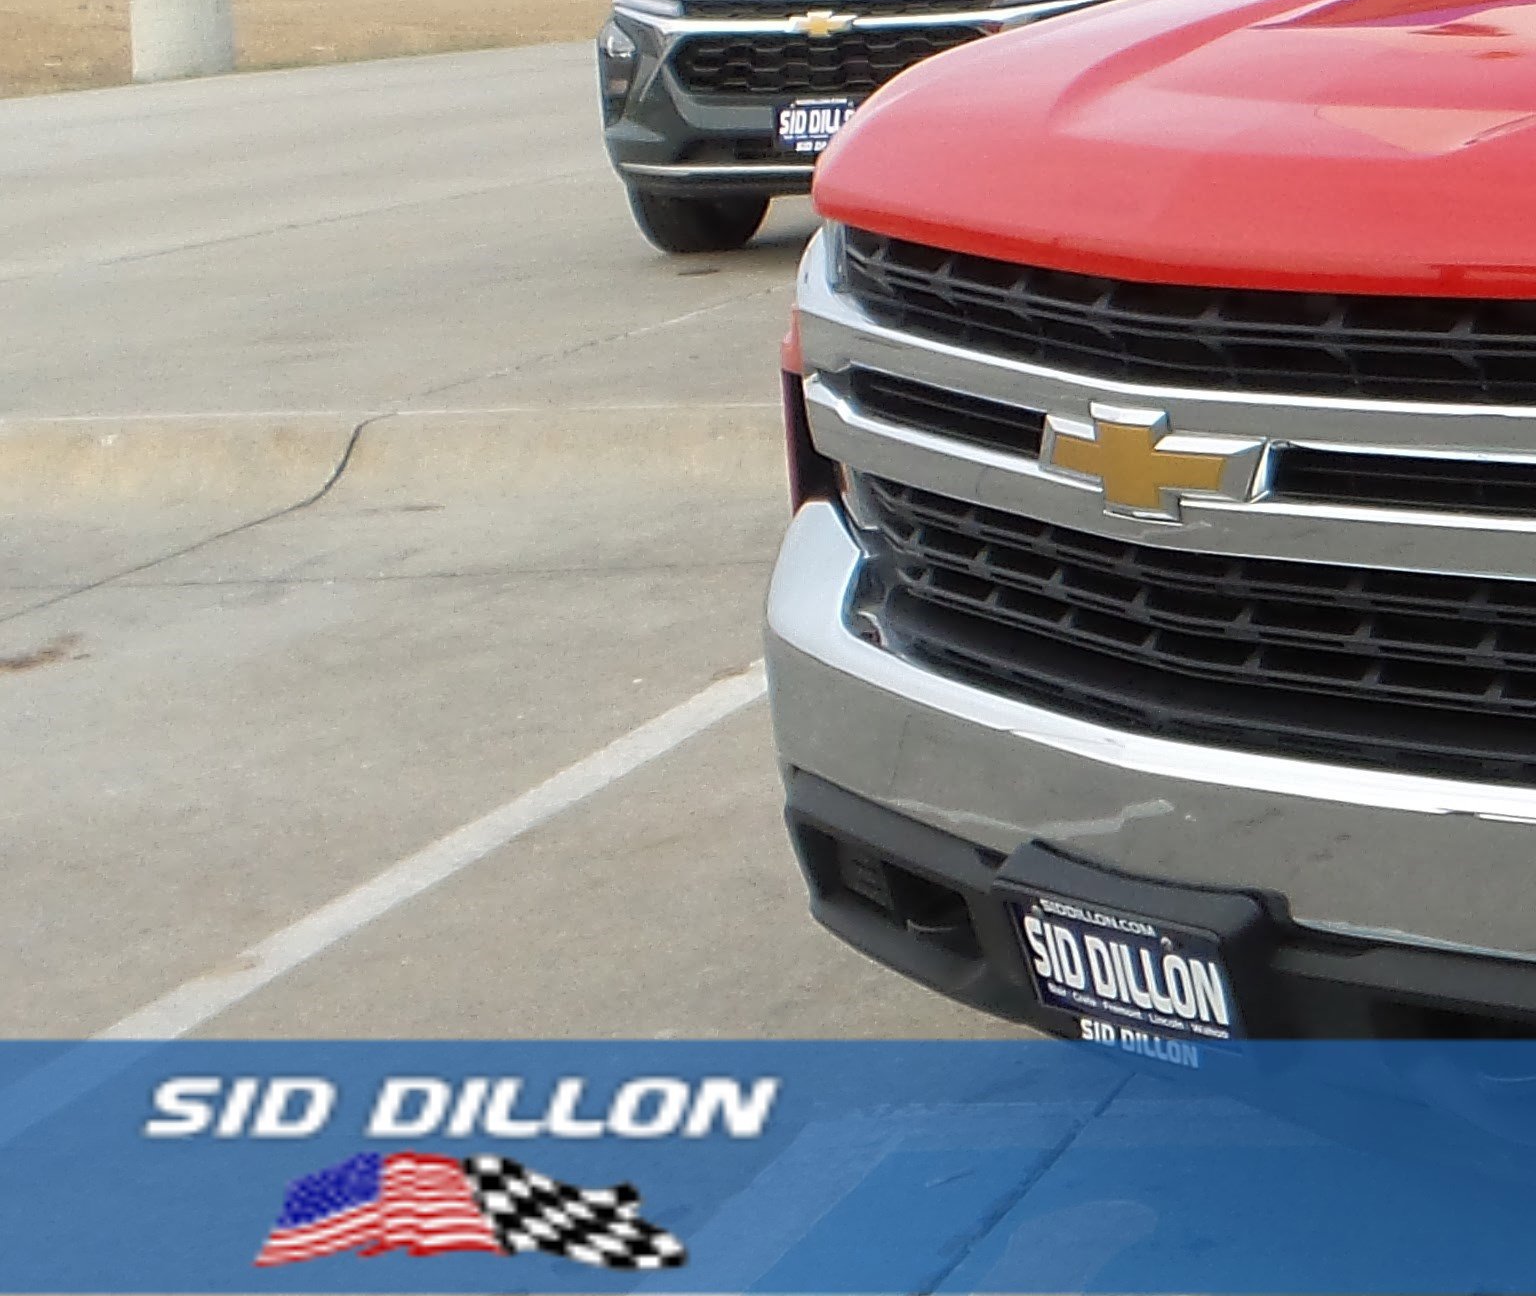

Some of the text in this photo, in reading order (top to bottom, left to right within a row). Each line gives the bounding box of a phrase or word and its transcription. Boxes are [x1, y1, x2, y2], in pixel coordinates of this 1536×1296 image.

[779, 109, 807, 135] SID
[1040, 899, 1157, 937] SIDDILLON.COM
[1024, 915, 1230, 1025] SID DILLON
[1080, 1019, 1200, 1069] SID DILLON
